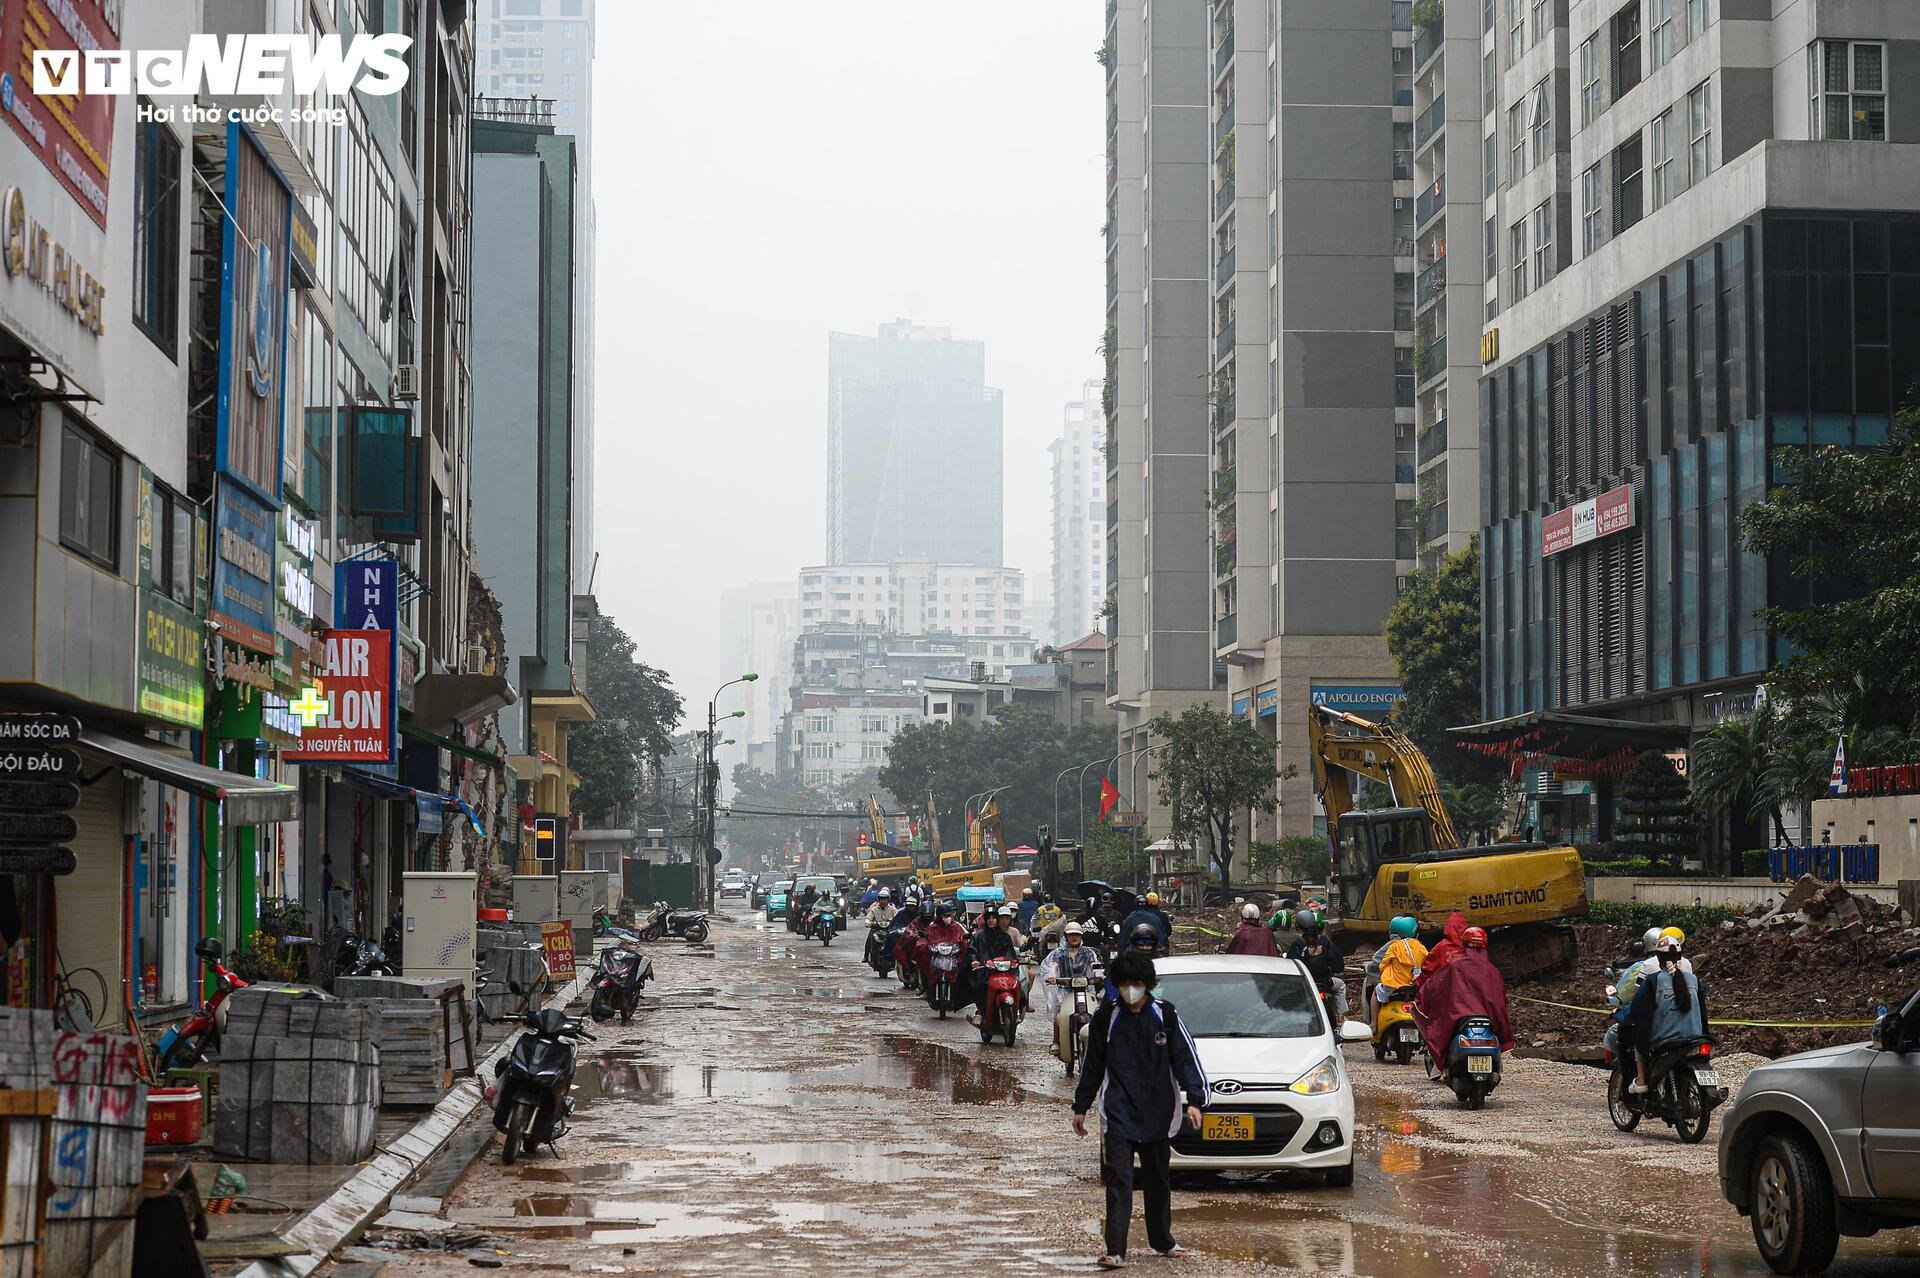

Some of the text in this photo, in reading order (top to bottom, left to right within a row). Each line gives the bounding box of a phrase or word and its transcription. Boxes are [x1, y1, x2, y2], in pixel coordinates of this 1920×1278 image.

[1328, 693, 1368, 703] APOLLO
[1370, 693, 1408, 703] ENGLIS
[319, 690, 381, 729] LON
[24, 721, 50, 738] SÓC
[53, 724, 70, 738] DA
[307, 733, 350, 752] NGUYỄN
[353, 736, 382, 753] TUÂN
[27, 752, 62, 772] ĐẦU
[944, 875, 974, 885] KOMATSU
[1469, 888, 1545, 909] SUMITOMO
[1217, 1116, 1240, 1127] 29G
[1208, 1127, 1249, 1139] 024.58
